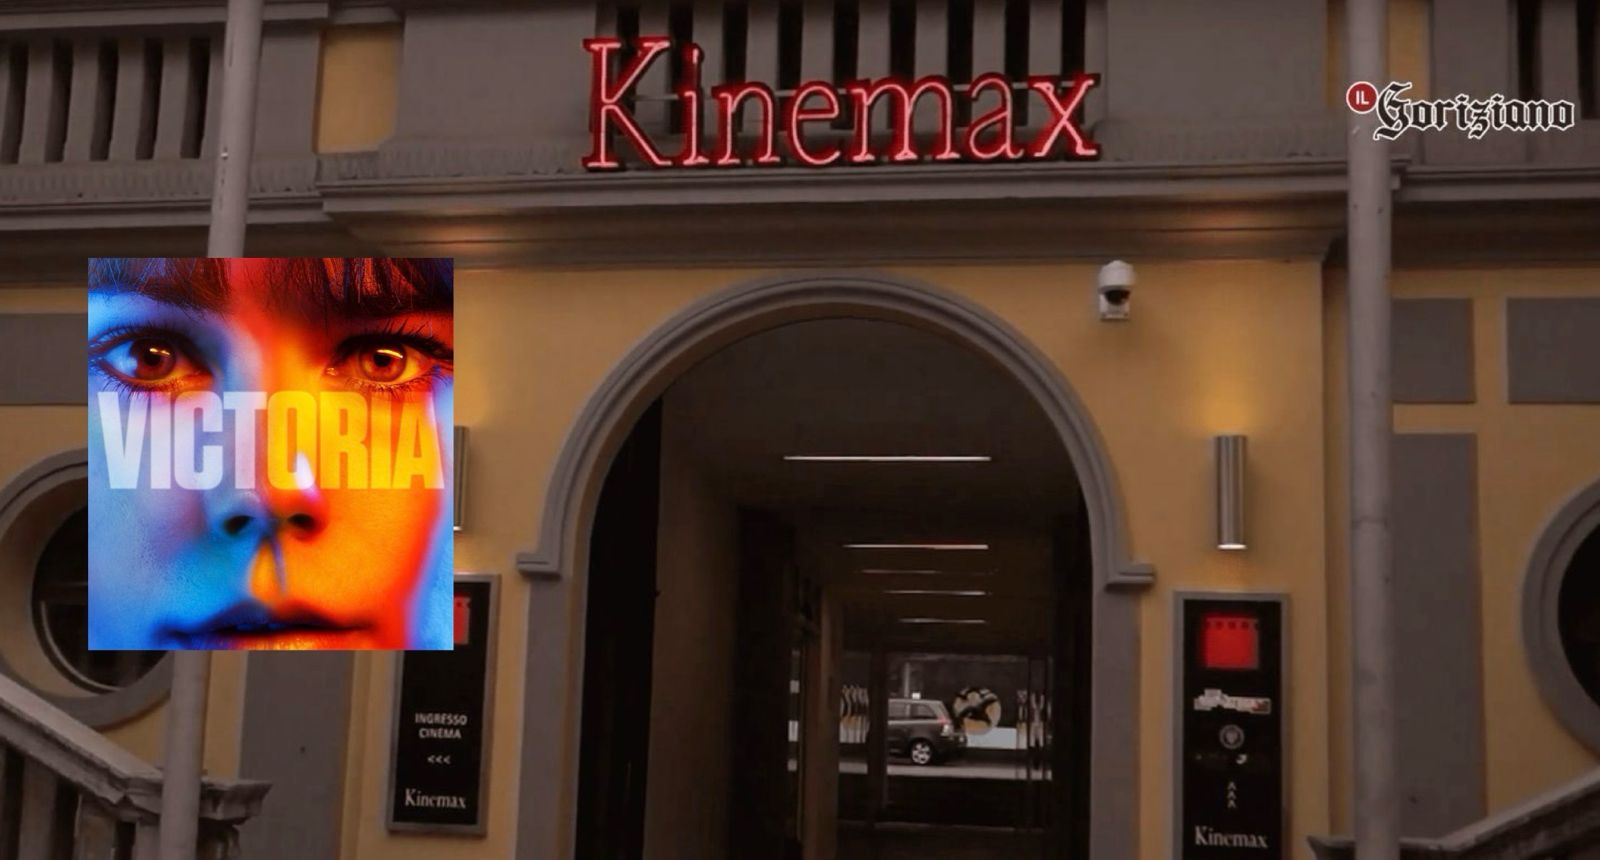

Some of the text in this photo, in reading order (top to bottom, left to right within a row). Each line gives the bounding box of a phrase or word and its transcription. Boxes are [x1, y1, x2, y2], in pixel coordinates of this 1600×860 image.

[583, 36, 1101, 171] Kinemax
[415, 713, 467, 725] INGRESSO
[419, 728, 461, 739] CINEMA
[405, 788, 466, 808] Kinemax
[1195, 825, 1268, 848] Kinemax
